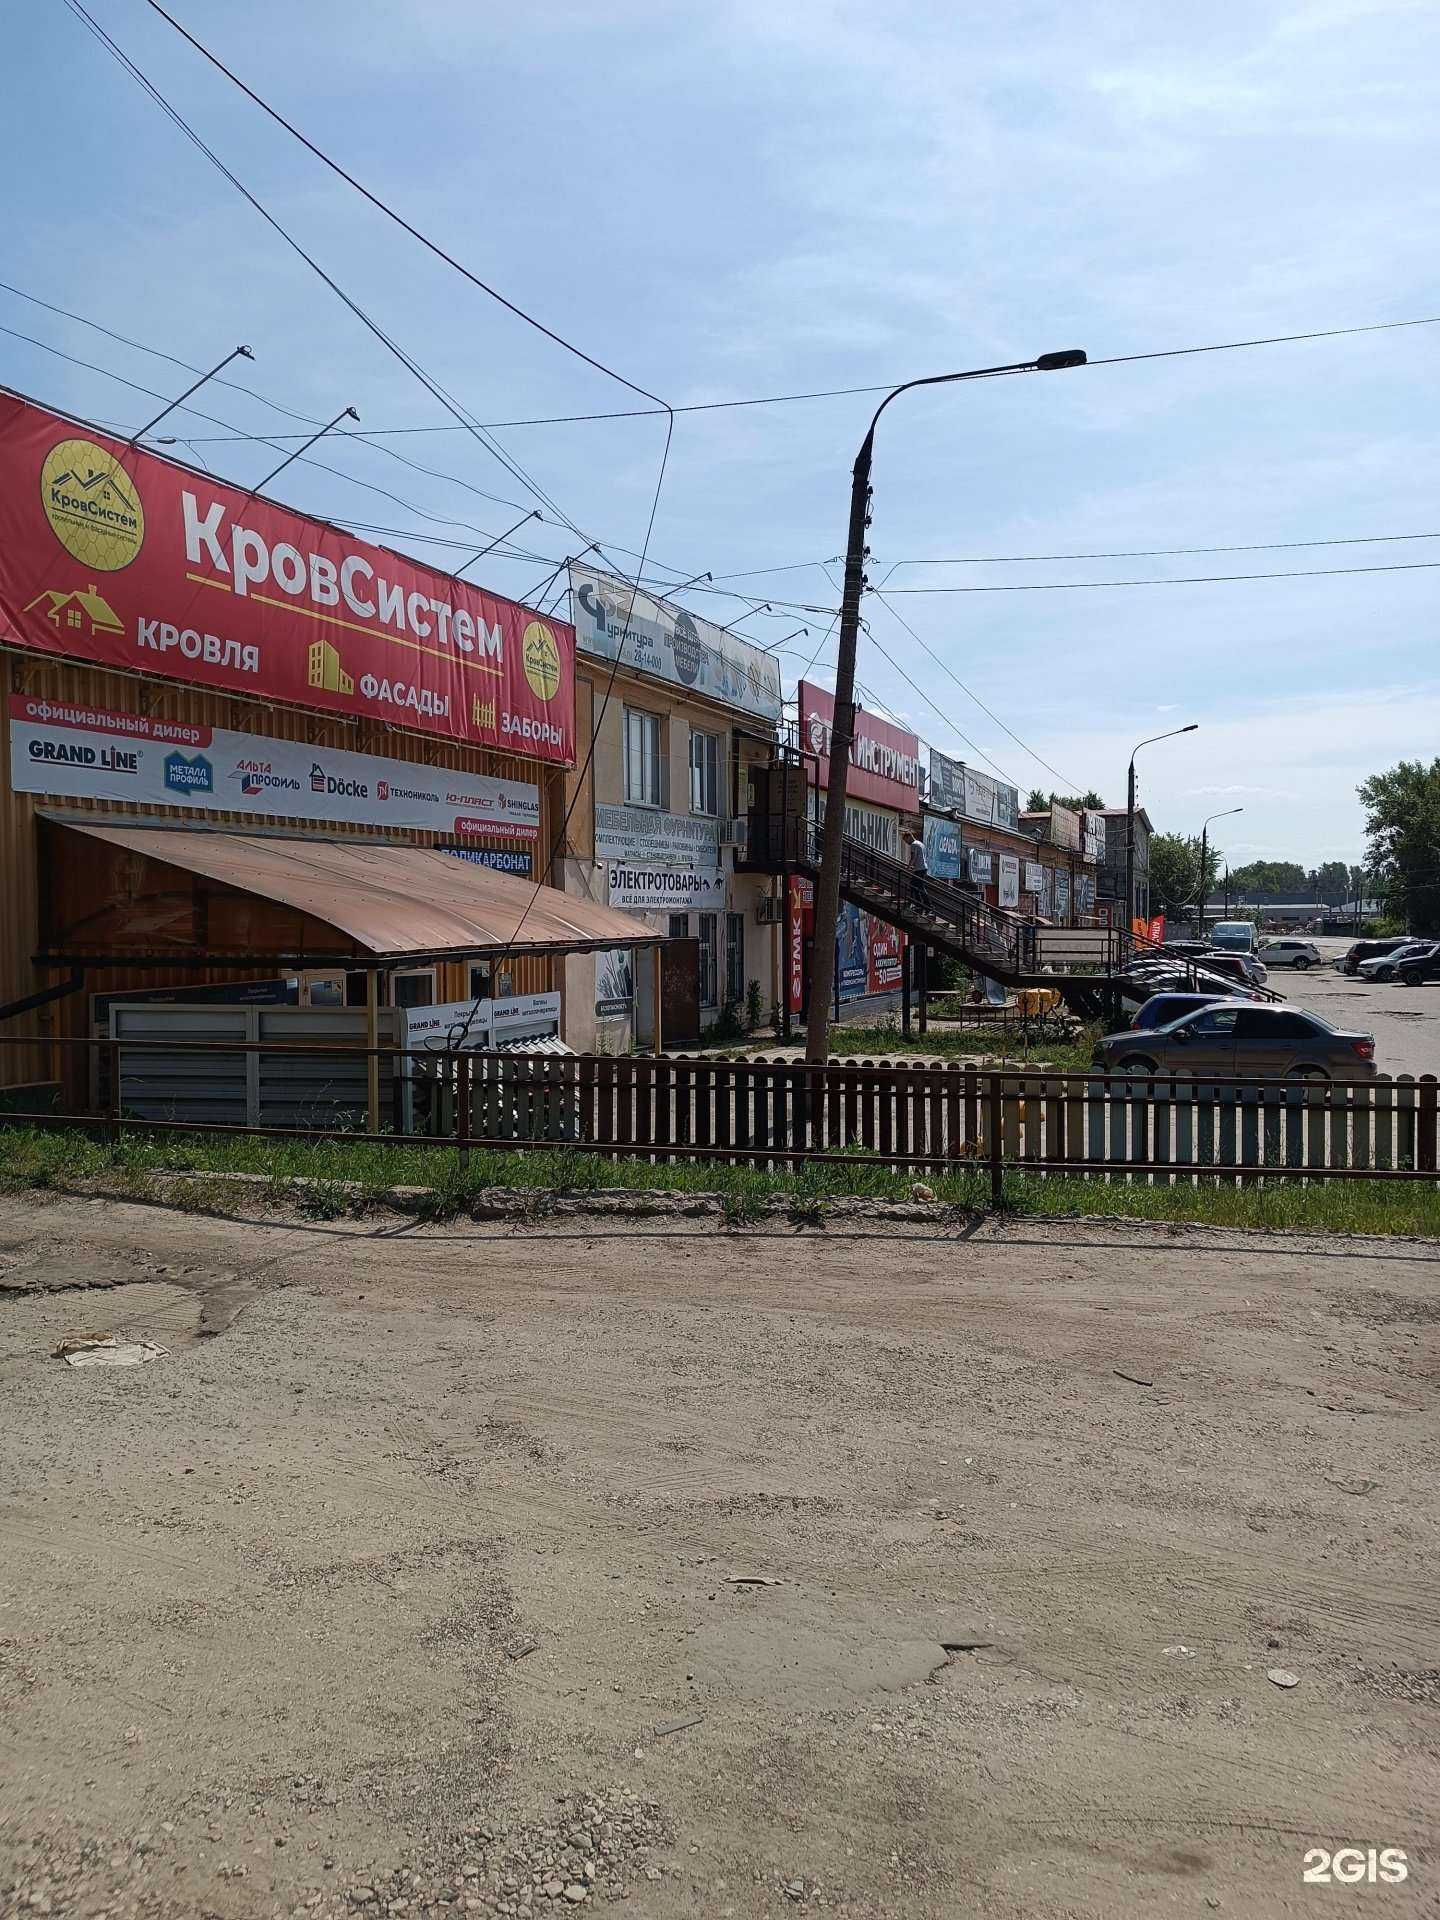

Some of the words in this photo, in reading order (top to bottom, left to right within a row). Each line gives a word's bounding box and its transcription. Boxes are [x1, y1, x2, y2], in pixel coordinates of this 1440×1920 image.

[50, 487, 137, 528] КровСистем
[181, 490, 504, 664] КровСистем
[136, 617, 260, 673] КРОВЛЯ
[360, 674, 449, 717] ФАСАДЫ
[26, 702, 149, 733] официальный
[153, 722, 200, 743] дилер
[501, 712, 563, 746] ЗАБОРЫ
[28, 740, 96, 764] GRAND
[857, 735, 919, 787] ИНСТРУМЕНТ
[169, 765, 206, 777] МЕТАЛЛ
[236, 759, 272, 774] АЛЬТА
[169, 773, 209, 786] ПРОФИЛЬ
[251, 773, 300, 790] ПРОФИЛЬ
[327, 776, 368, 798] Döcke
[390, 787, 440, 802] ТЕХНОНИКОЛЬ
[507, 799, 539, 811] SHINGLAS
[461, 820, 515, 833] официальный
[516, 828, 538, 839] дилер
[440, 849, 531, 871] ЛИКАРБОНАТ
[610, 870, 702, 892] ЭЛЕКТРОТОВАРЫ
[633, 896, 645, 905] ДЛЯ
[645, 896, 693, 905] ЭЛЕКТРОМОНТАЖА
[409, 1021, 428, 1030] GRAND
